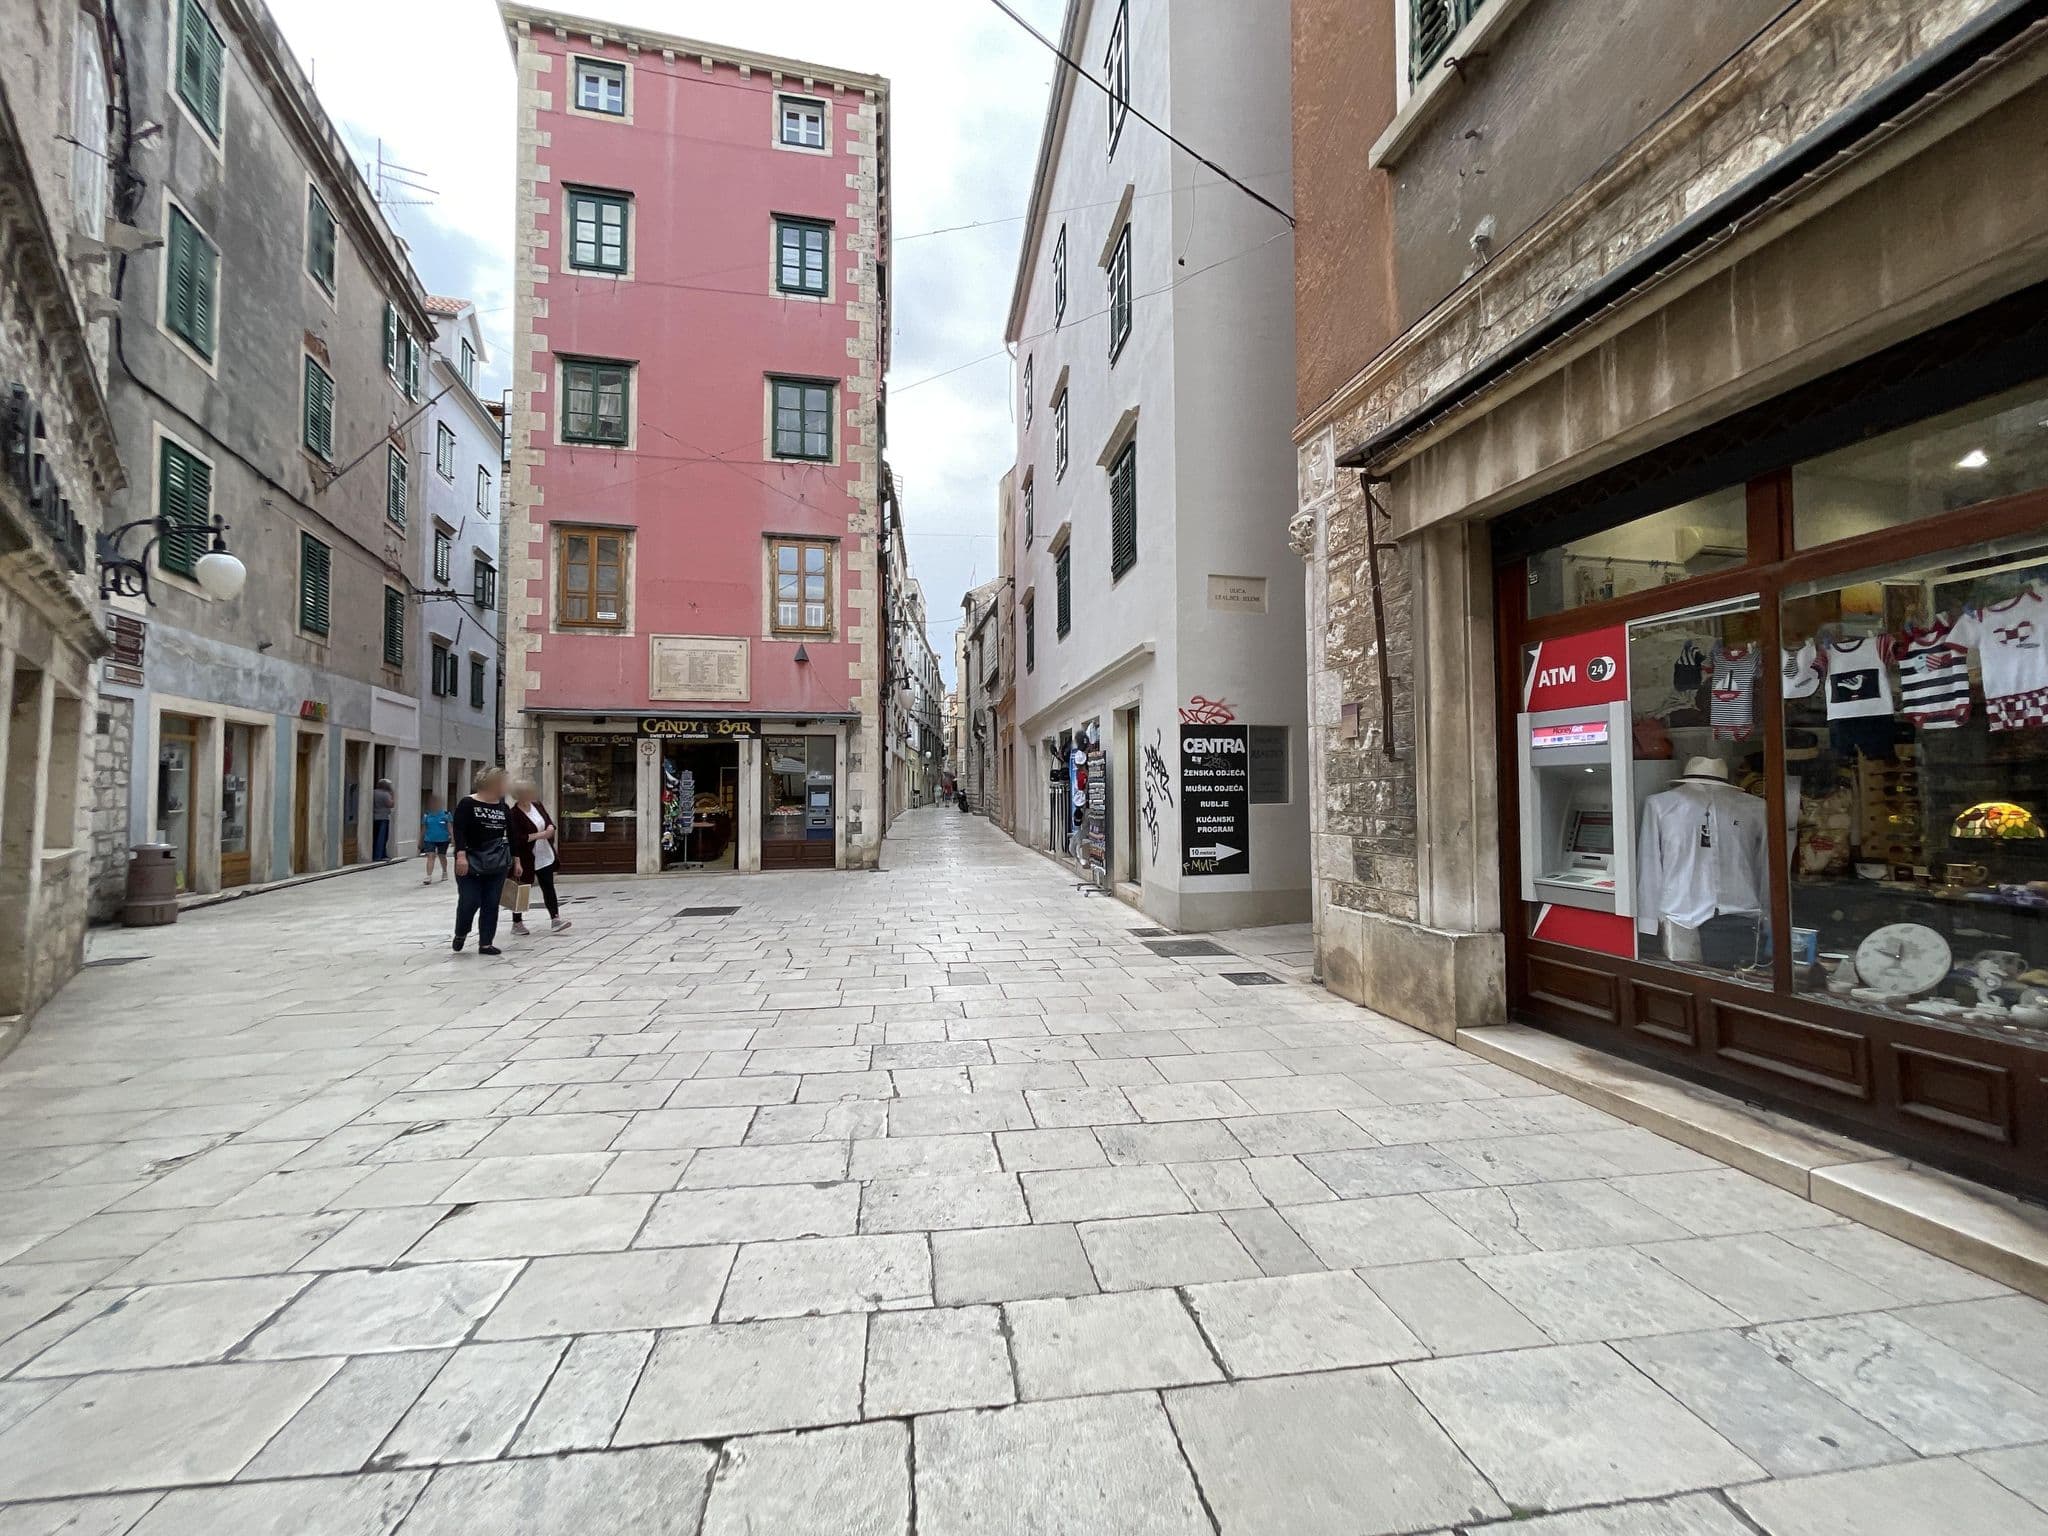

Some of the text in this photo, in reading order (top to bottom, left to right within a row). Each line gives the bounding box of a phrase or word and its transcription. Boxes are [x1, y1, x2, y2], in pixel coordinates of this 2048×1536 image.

[1592, 665, 1603, 675] 24
[1539, 665, 1576, 688] ATM
[642, 718, 756, 734] CANDY BAR
[1182, 737, 1246, 754] CENTRA
[1184, 768, 1214, 776] ŽENSKA
[1186, 784, 1213, 792] MUŠKA
[1196, 814, 1234, 823] KUĆANSKI
[1197, 825, 1234, 833] PROGRAM
